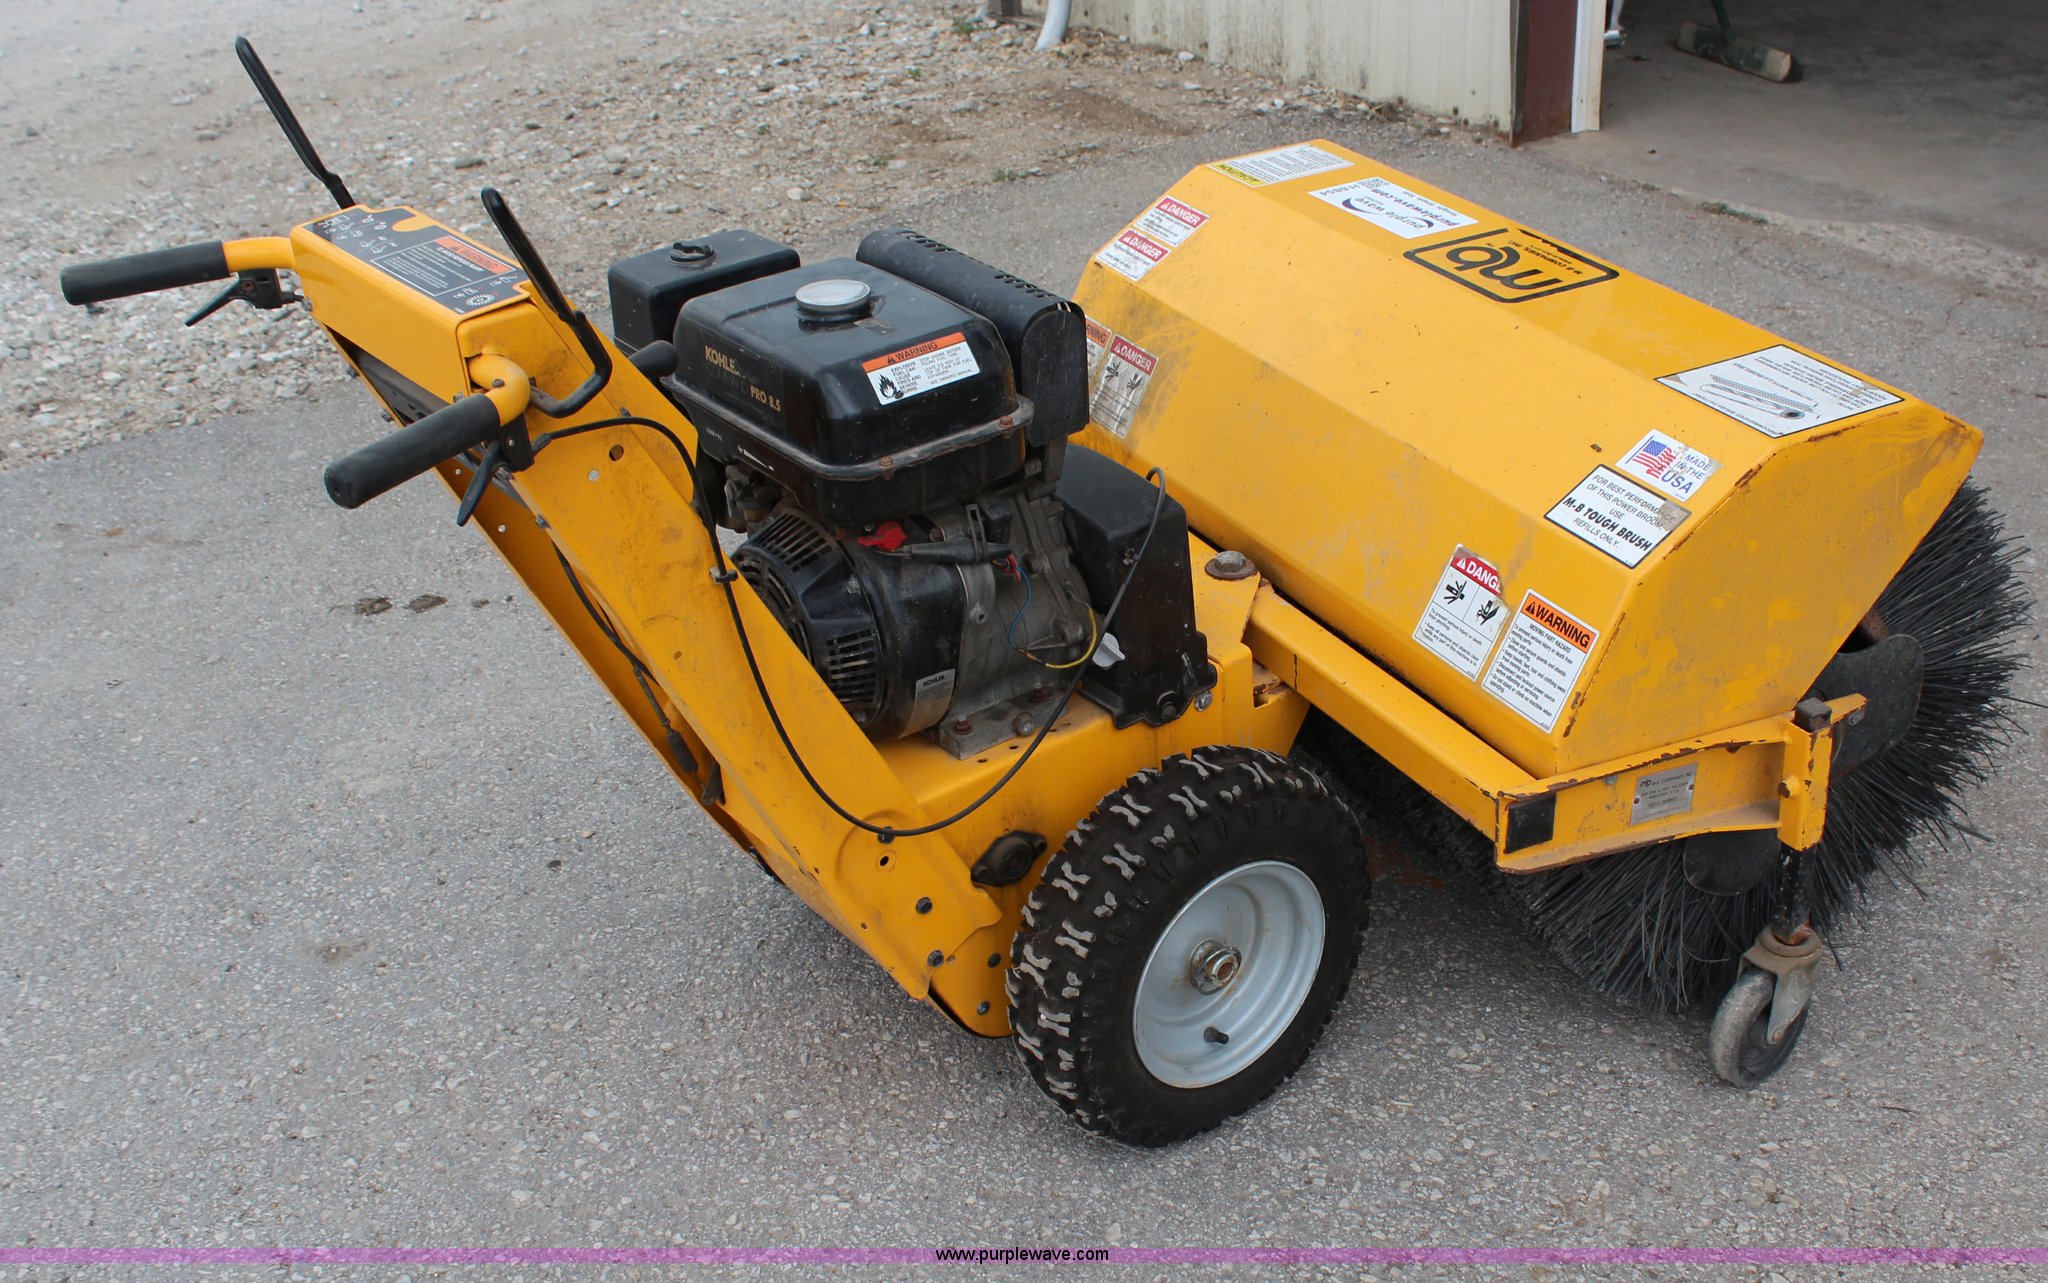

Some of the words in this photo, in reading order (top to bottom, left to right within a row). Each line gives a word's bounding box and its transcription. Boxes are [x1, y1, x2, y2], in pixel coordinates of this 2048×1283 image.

[1168, 205, 1200, 224] DANGER
[1355, 198, 1384, 211] wave
[1372, 189, 1458, 226] purplewave.com
[1385, 212, 1425, 228] purple
[1130, 238, 1161, 258] DANGER
[896, 342, 937, 359] WARNING
[1121, 346, 1151, 369] DANGER
[750, 386, 766, 403] PRO
[769, 396, 780, 411] 8.5
[1674, 461, 1686, 470] IN
[1686, 467, 1704, 479] THE
[1685, 455, 1711, 470] MADE
[1662, 470, 1692, 493] USA
[1587, 483, 1598, 491] OF
[1597, 489, 1613, 500] THIS
[1612, 497, 1637, 513] POWER
[1593, 475, 1608, 485] FOR
[1607, 482, 1625, 494] BEST
[1625, 492, 1676, 522] PERFORMANCE
[1563, 497, 1585, 512] M-B
[1584, 508, 1618, 531] TOUGH
[1617, 528, 1651, 550] BRUSH
[1609, 508, 1625, 519] USE
[1573, 518, 1600, 535] REFILLS
[1599, 533, 1620, 548] ONLY.
[1529, 624, 1544, 636] MOVING
[1545, 633, 1555, 642] PART
[1555, 640, 1571, 653] HAZARD
[1535, 606, 1591, 648] WARNING
[1518, 627, 1531, 637] prevent
[1530, 635, 1542, 644] serious
[1542, 643, 1551, 651] injury
[1555, 651, 1565, 659] death
[1565, 656, 1573, 664] from
[923, 675, 945, 687] KOHLER
